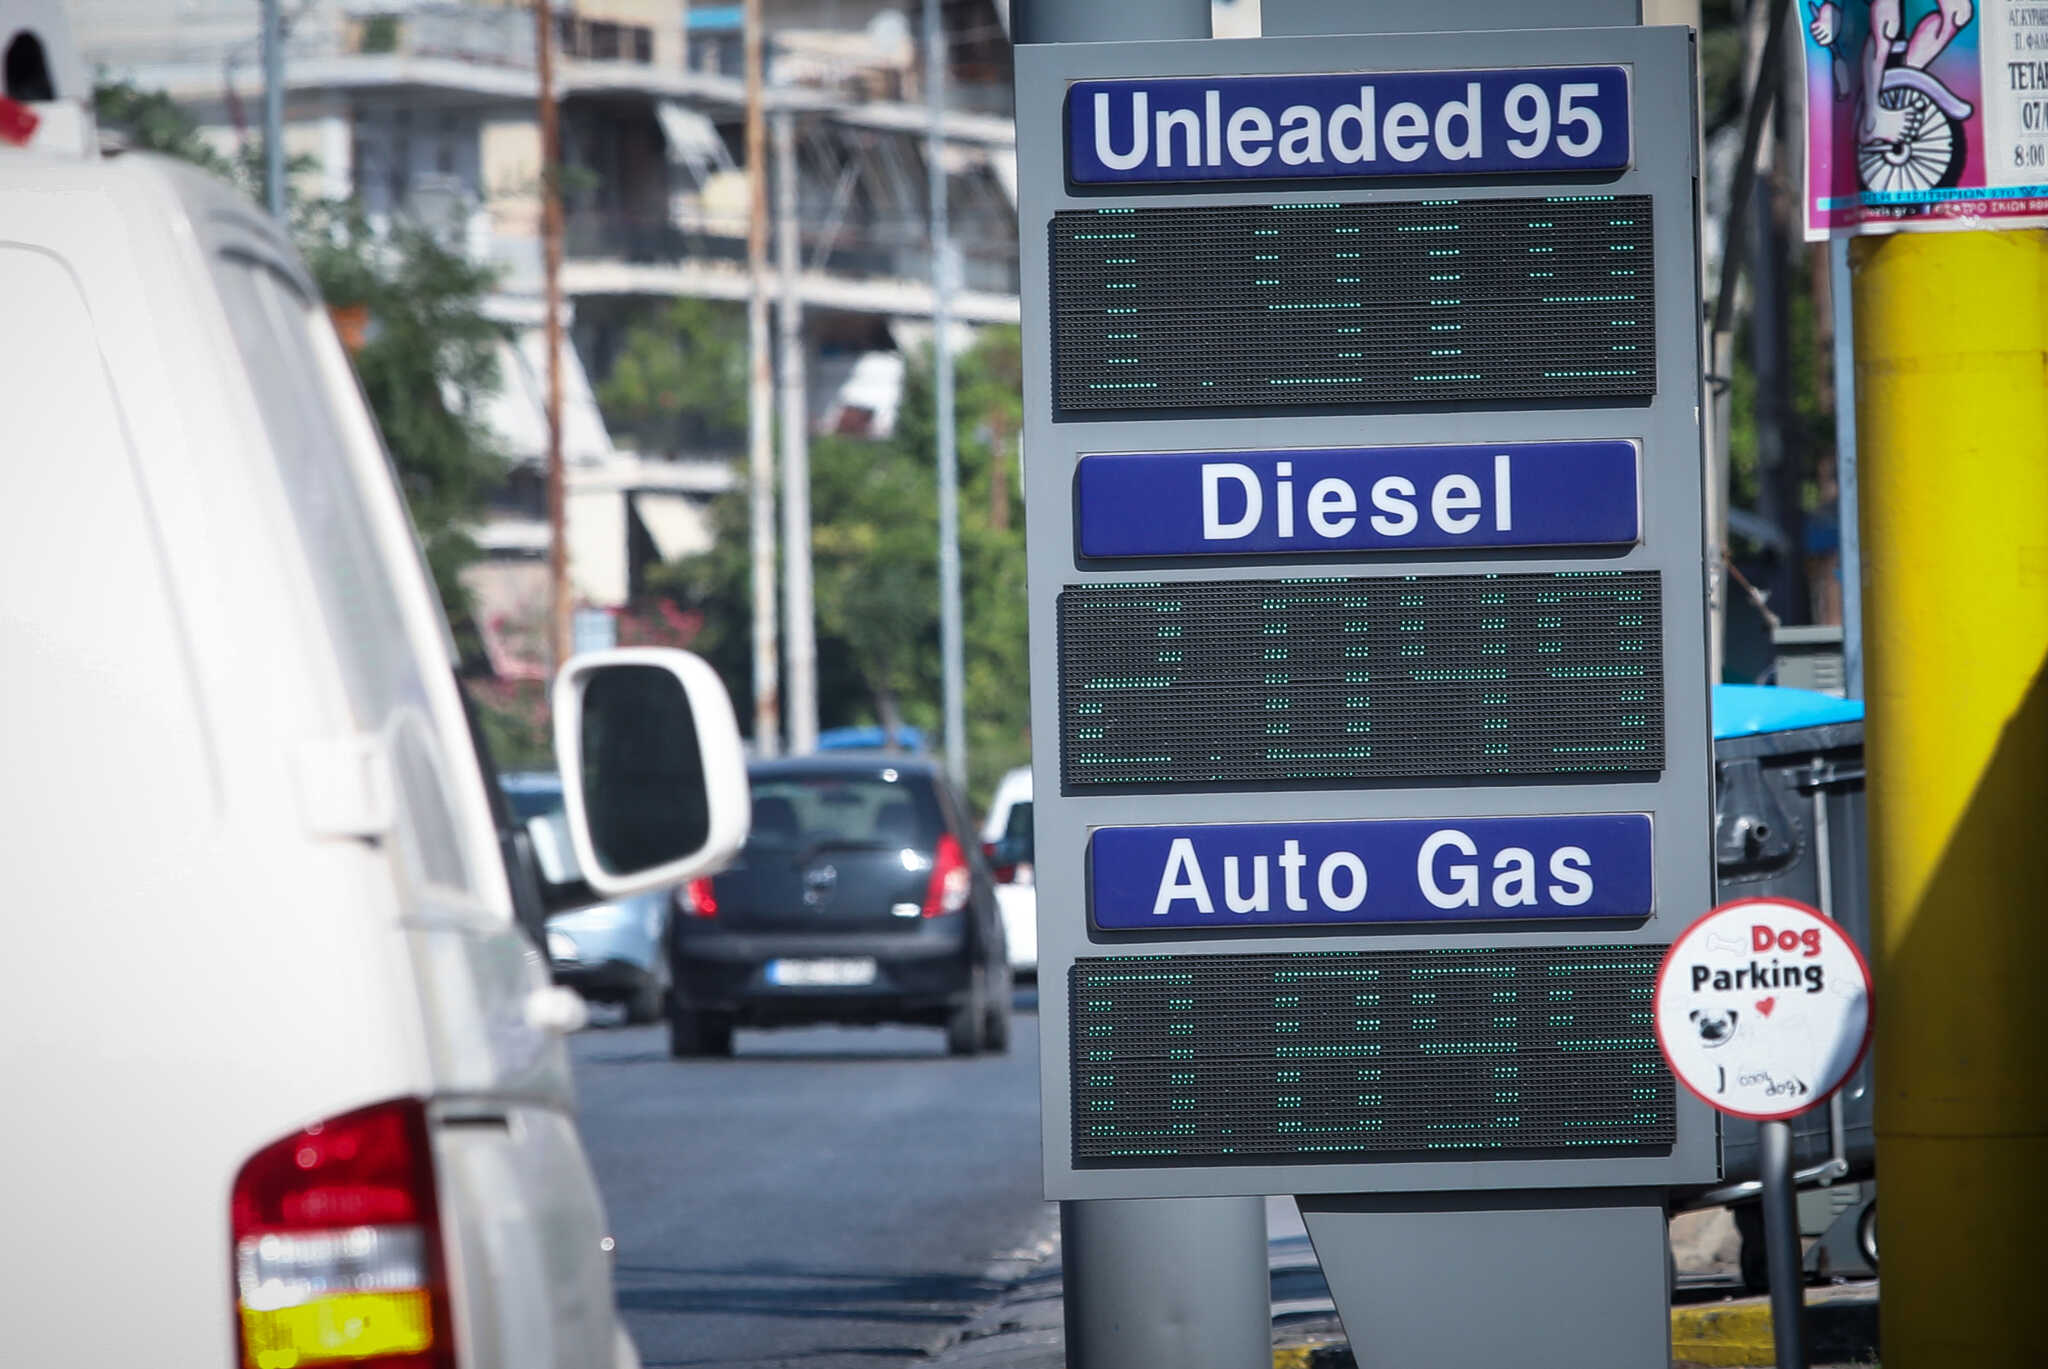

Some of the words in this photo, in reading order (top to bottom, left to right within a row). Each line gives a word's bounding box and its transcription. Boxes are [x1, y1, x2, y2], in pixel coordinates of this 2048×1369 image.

[1093, 82, 1483, 171] Unleaded
[1503, 82, 1604, 160] 95
[1200, 455, 1513, 541] Diesel
[1152, 837, 1368, 916] Auto
[1416, 828, 1594, 908] Gas
[1691, 959, 1824, 993] Parking
[1751, 925, 1822, 957] Dog
